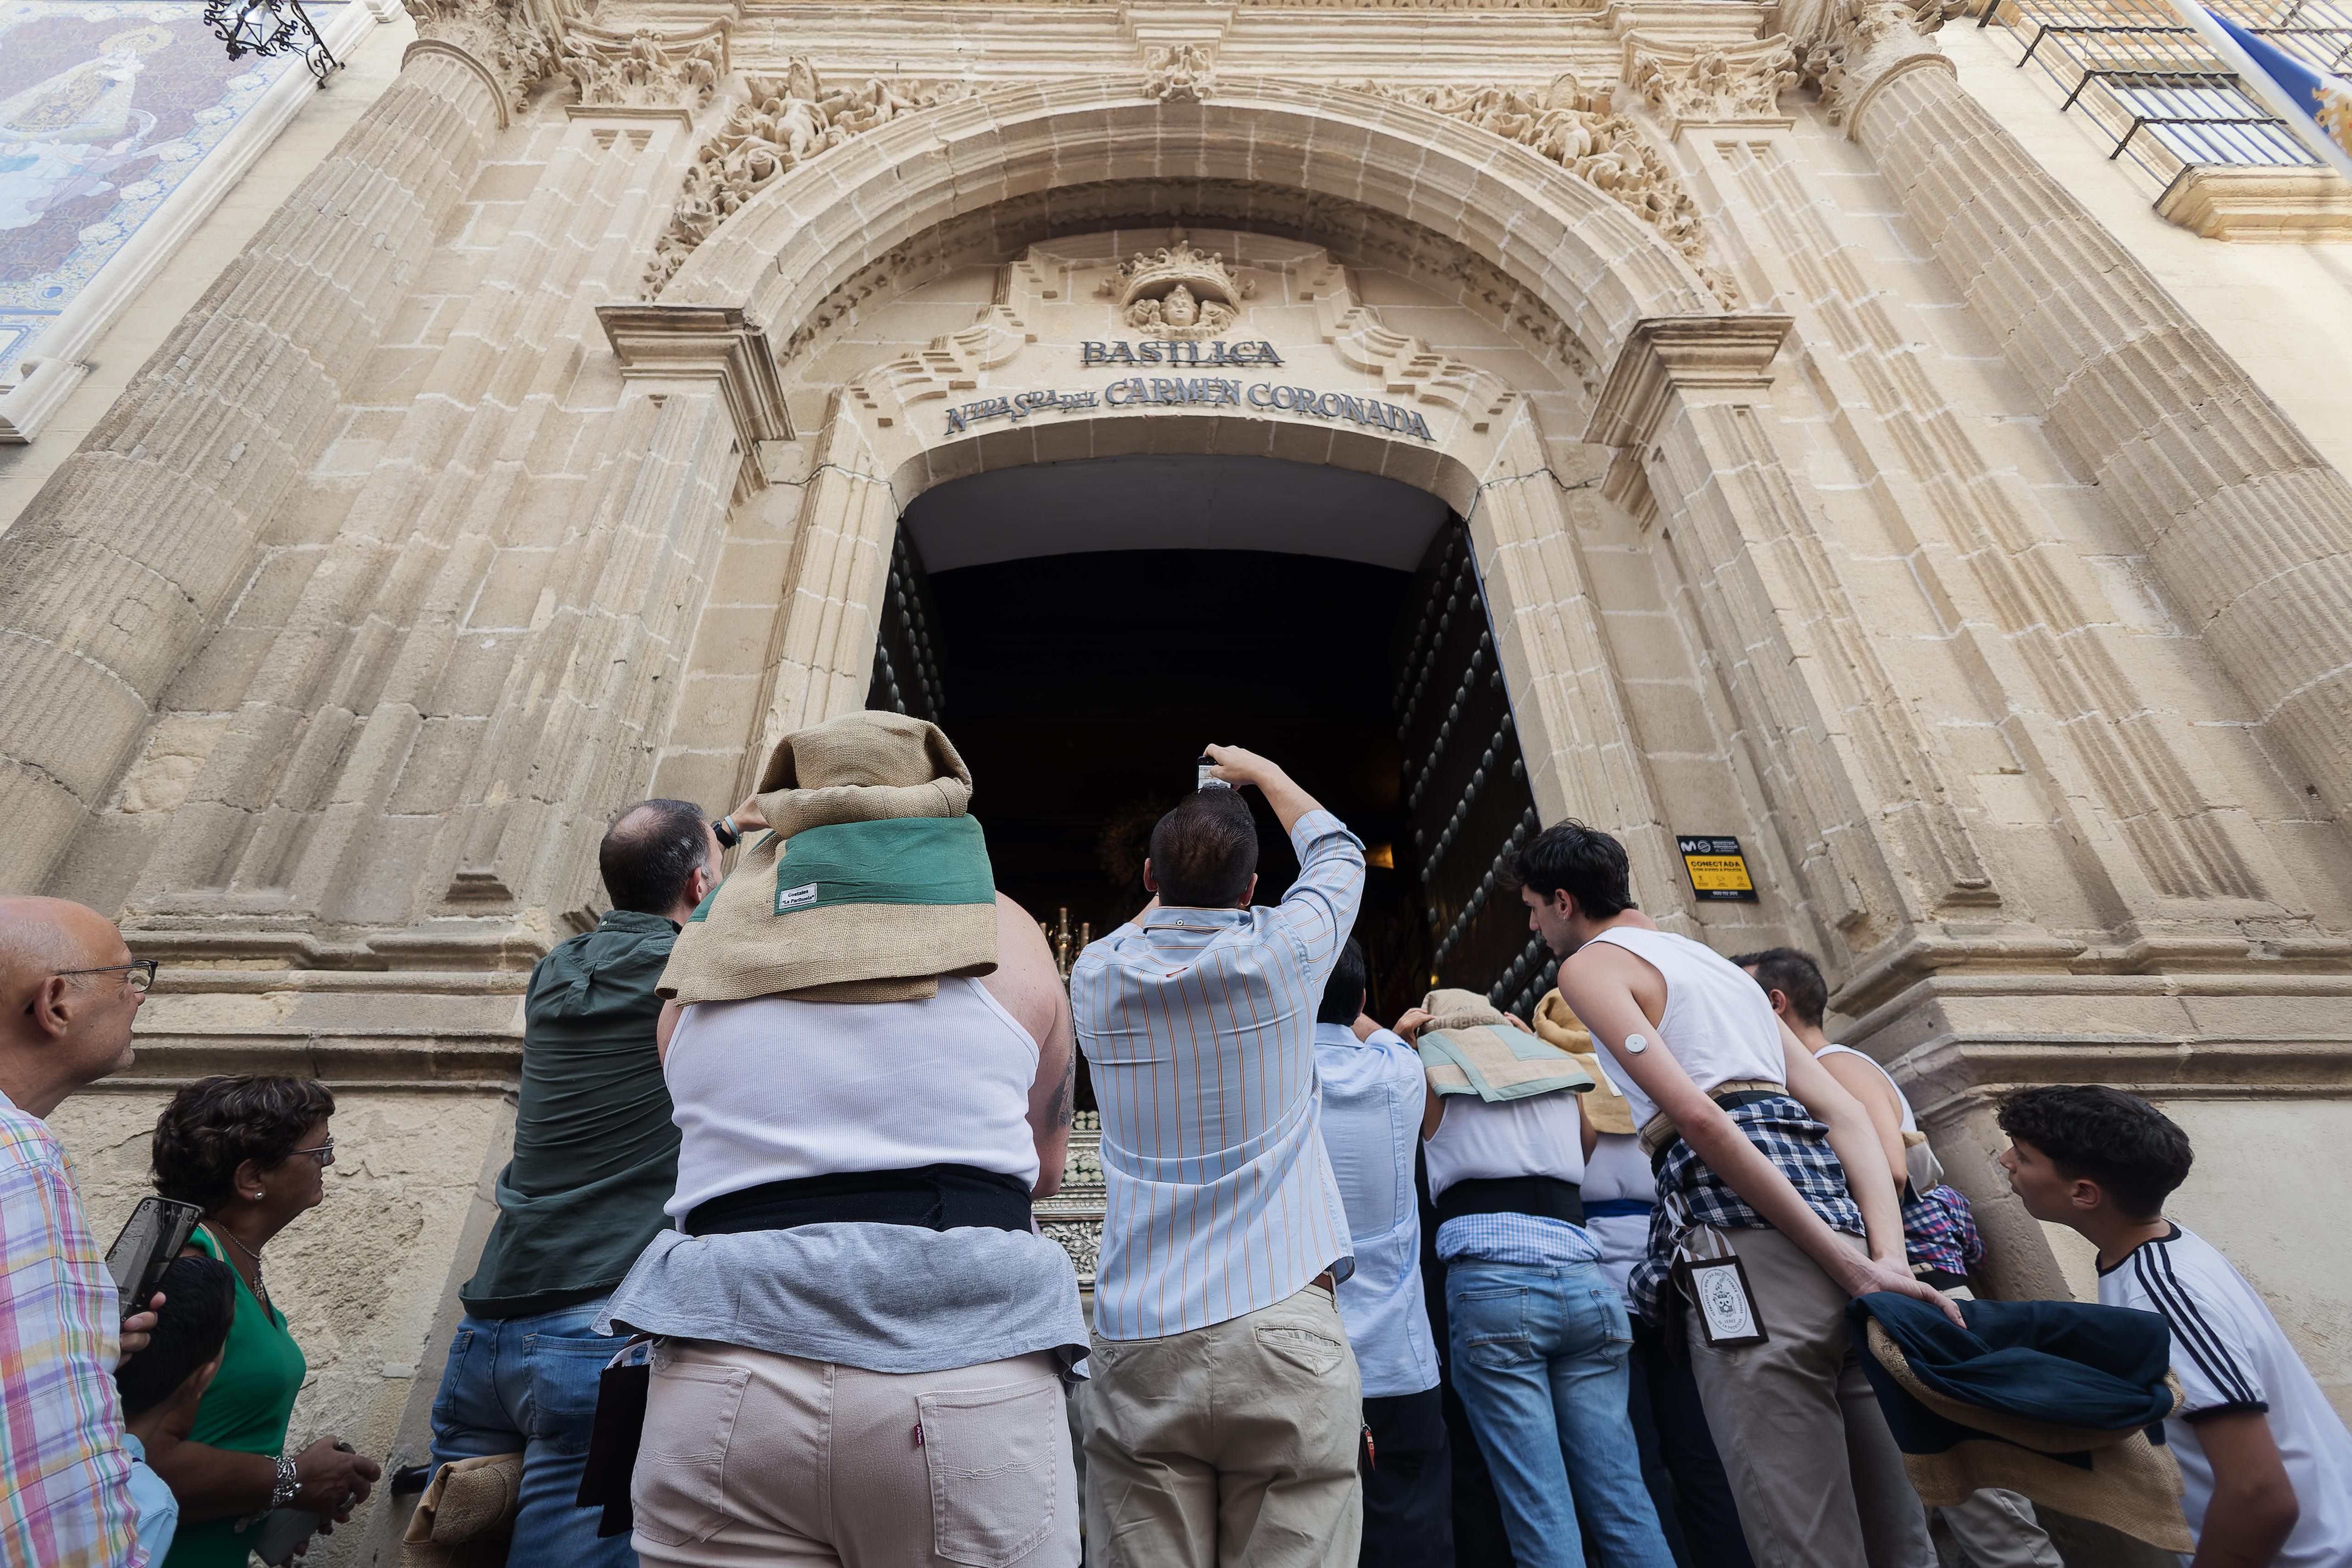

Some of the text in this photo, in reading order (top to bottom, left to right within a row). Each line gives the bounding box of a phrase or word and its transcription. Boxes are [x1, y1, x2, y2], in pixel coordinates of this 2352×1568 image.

[1080, 341, 1286, 363] BASILICA
[1059, 390, 1101, 409] DEL
[1105, 377, 1243, 406] CARMEN
[1247, 382, 1437, 442] CORONADA
